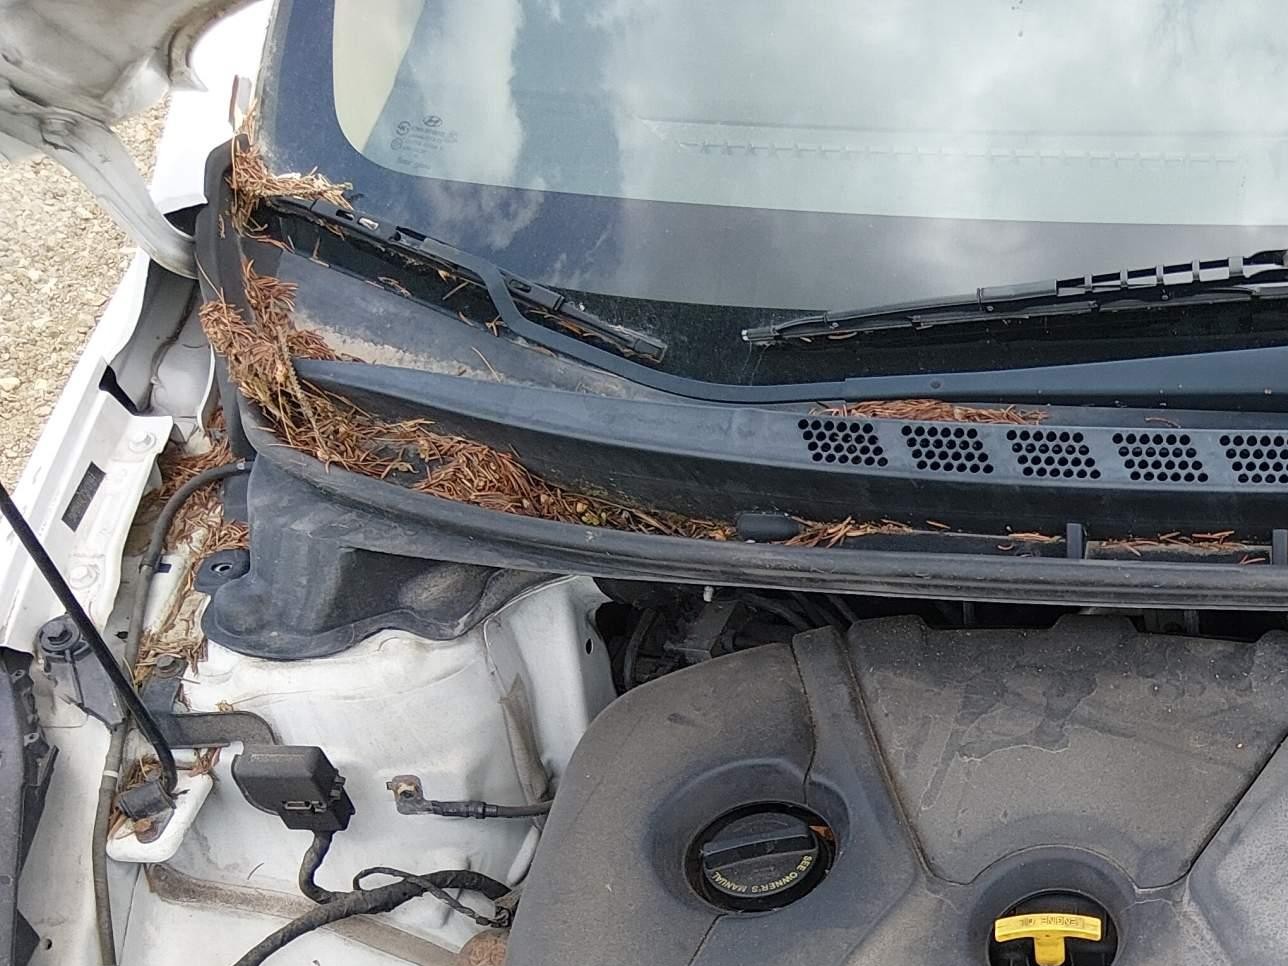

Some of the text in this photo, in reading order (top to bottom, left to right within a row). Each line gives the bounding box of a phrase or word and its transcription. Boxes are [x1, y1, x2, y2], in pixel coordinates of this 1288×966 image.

[712, 855, 813, 894] SEE OWNER'S MANUAL
